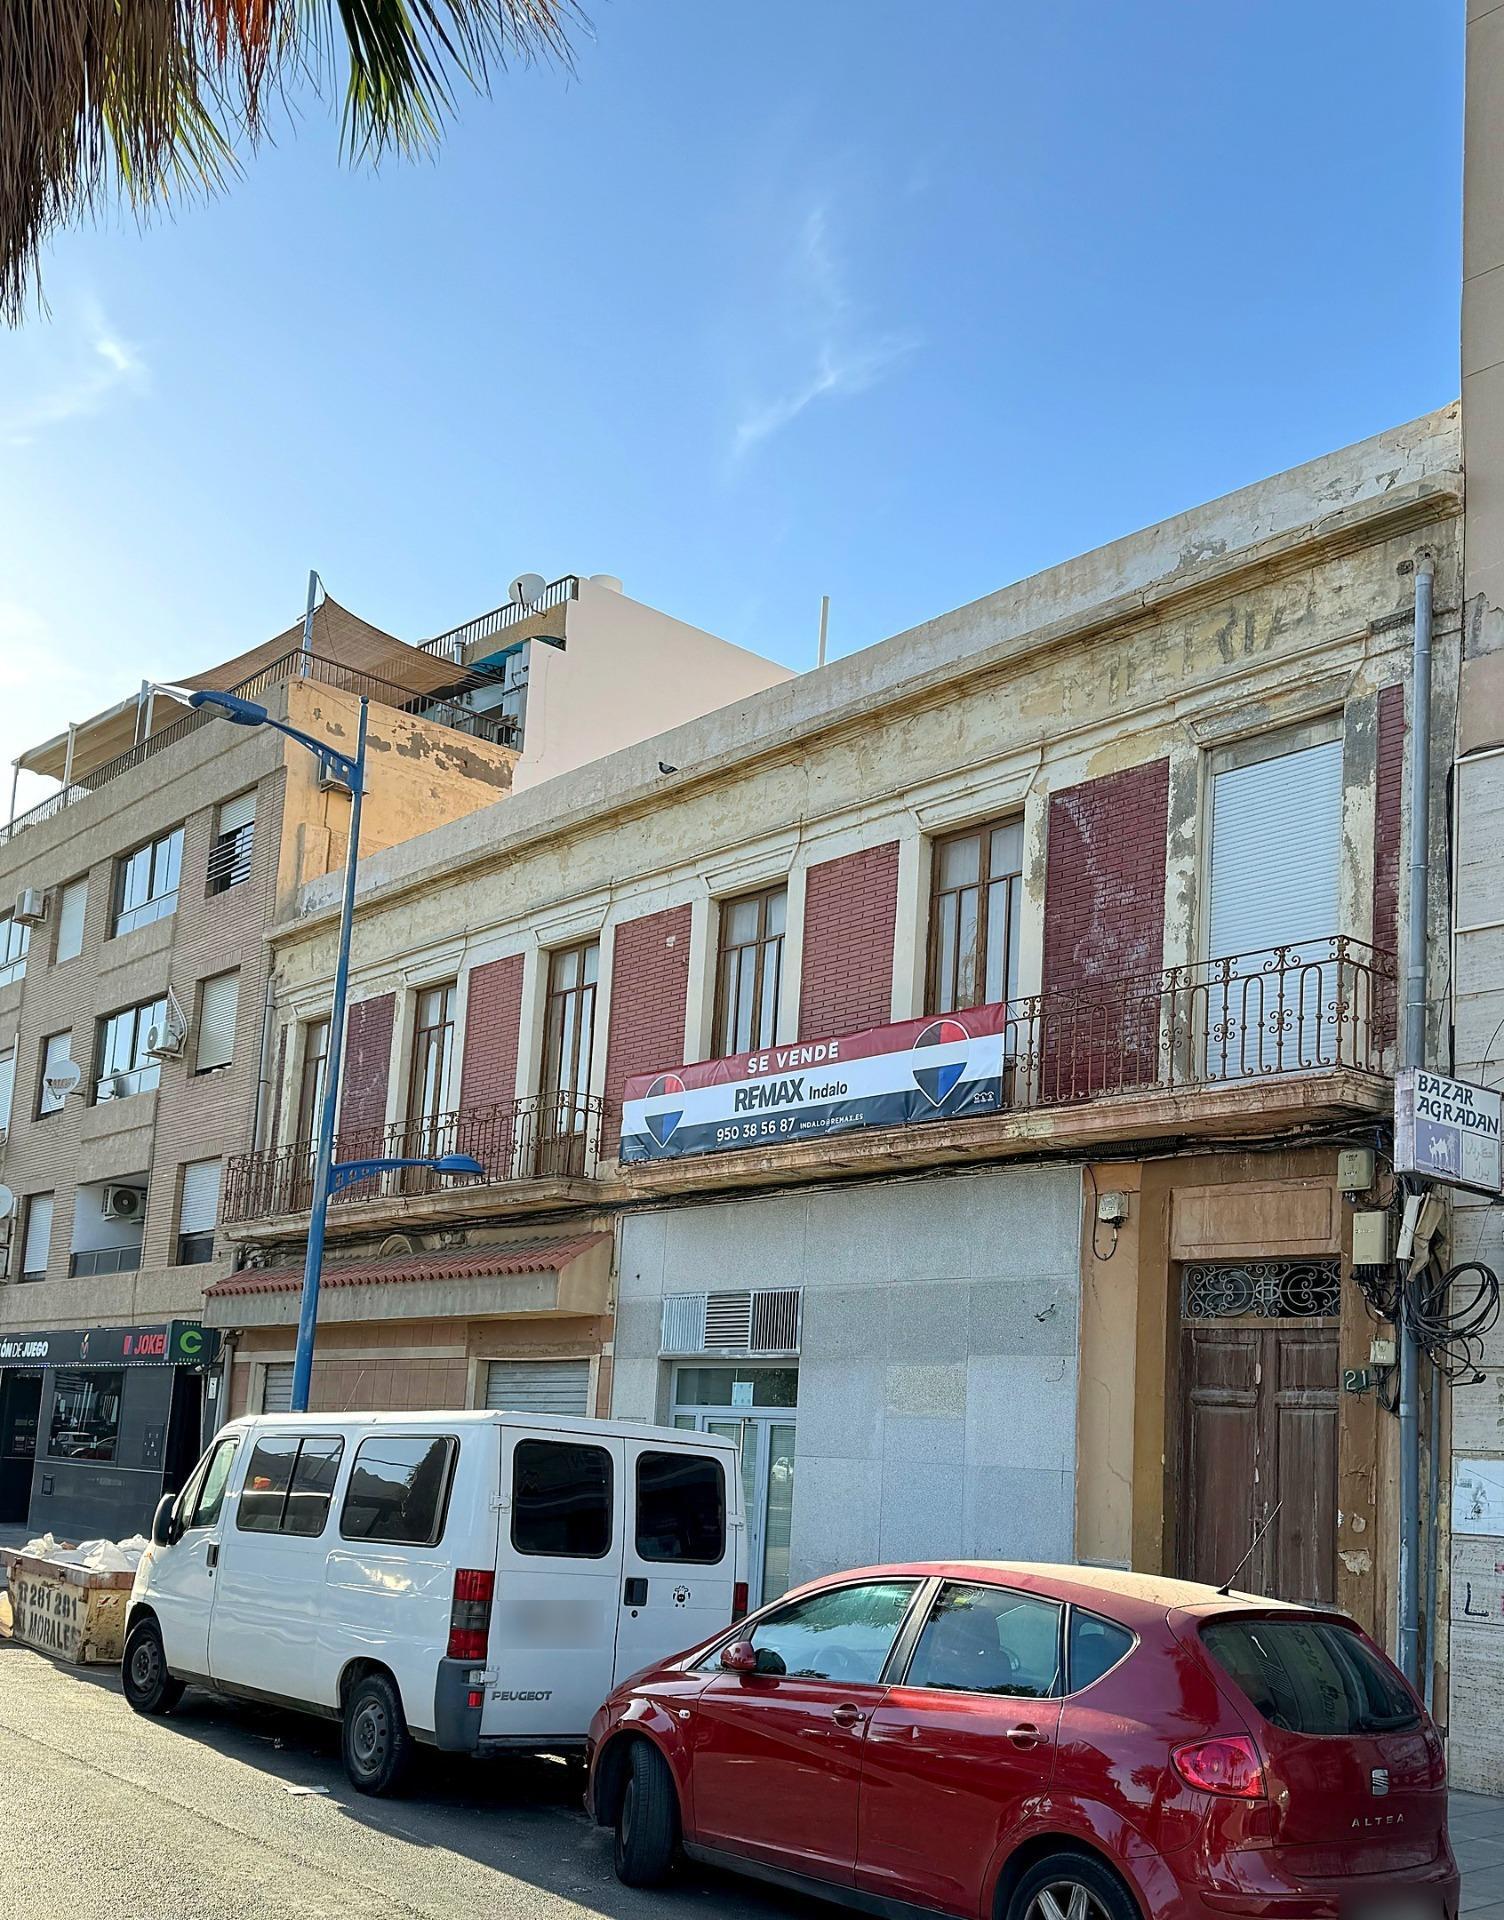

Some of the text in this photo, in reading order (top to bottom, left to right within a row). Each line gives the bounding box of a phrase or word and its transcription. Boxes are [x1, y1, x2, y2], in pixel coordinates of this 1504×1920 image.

[747, 1041, 839, 1074] SE VENDE
[809, 1081, 848, 1100] Indalo
[1418, 1074, 1474, 1107] BAZAR
[1417, 1096, 1499, 1134] AGRADAN
[716, 1126, 739, 1142] 950
[742, 1123, 757, 1138] 38
[761, 1120, 776, 1135] 56
[779, 1117, 796, 1132] 87
[0, 1337, 13, 1358] ÓN
[22, 1341, 49, 1358] JUEGO
[1345, 1370, 1366, 1390] 21
[491, 1690, 553, 1701] PEUGEOT
[1352, 1813, 1405, 1828] ALTEA
